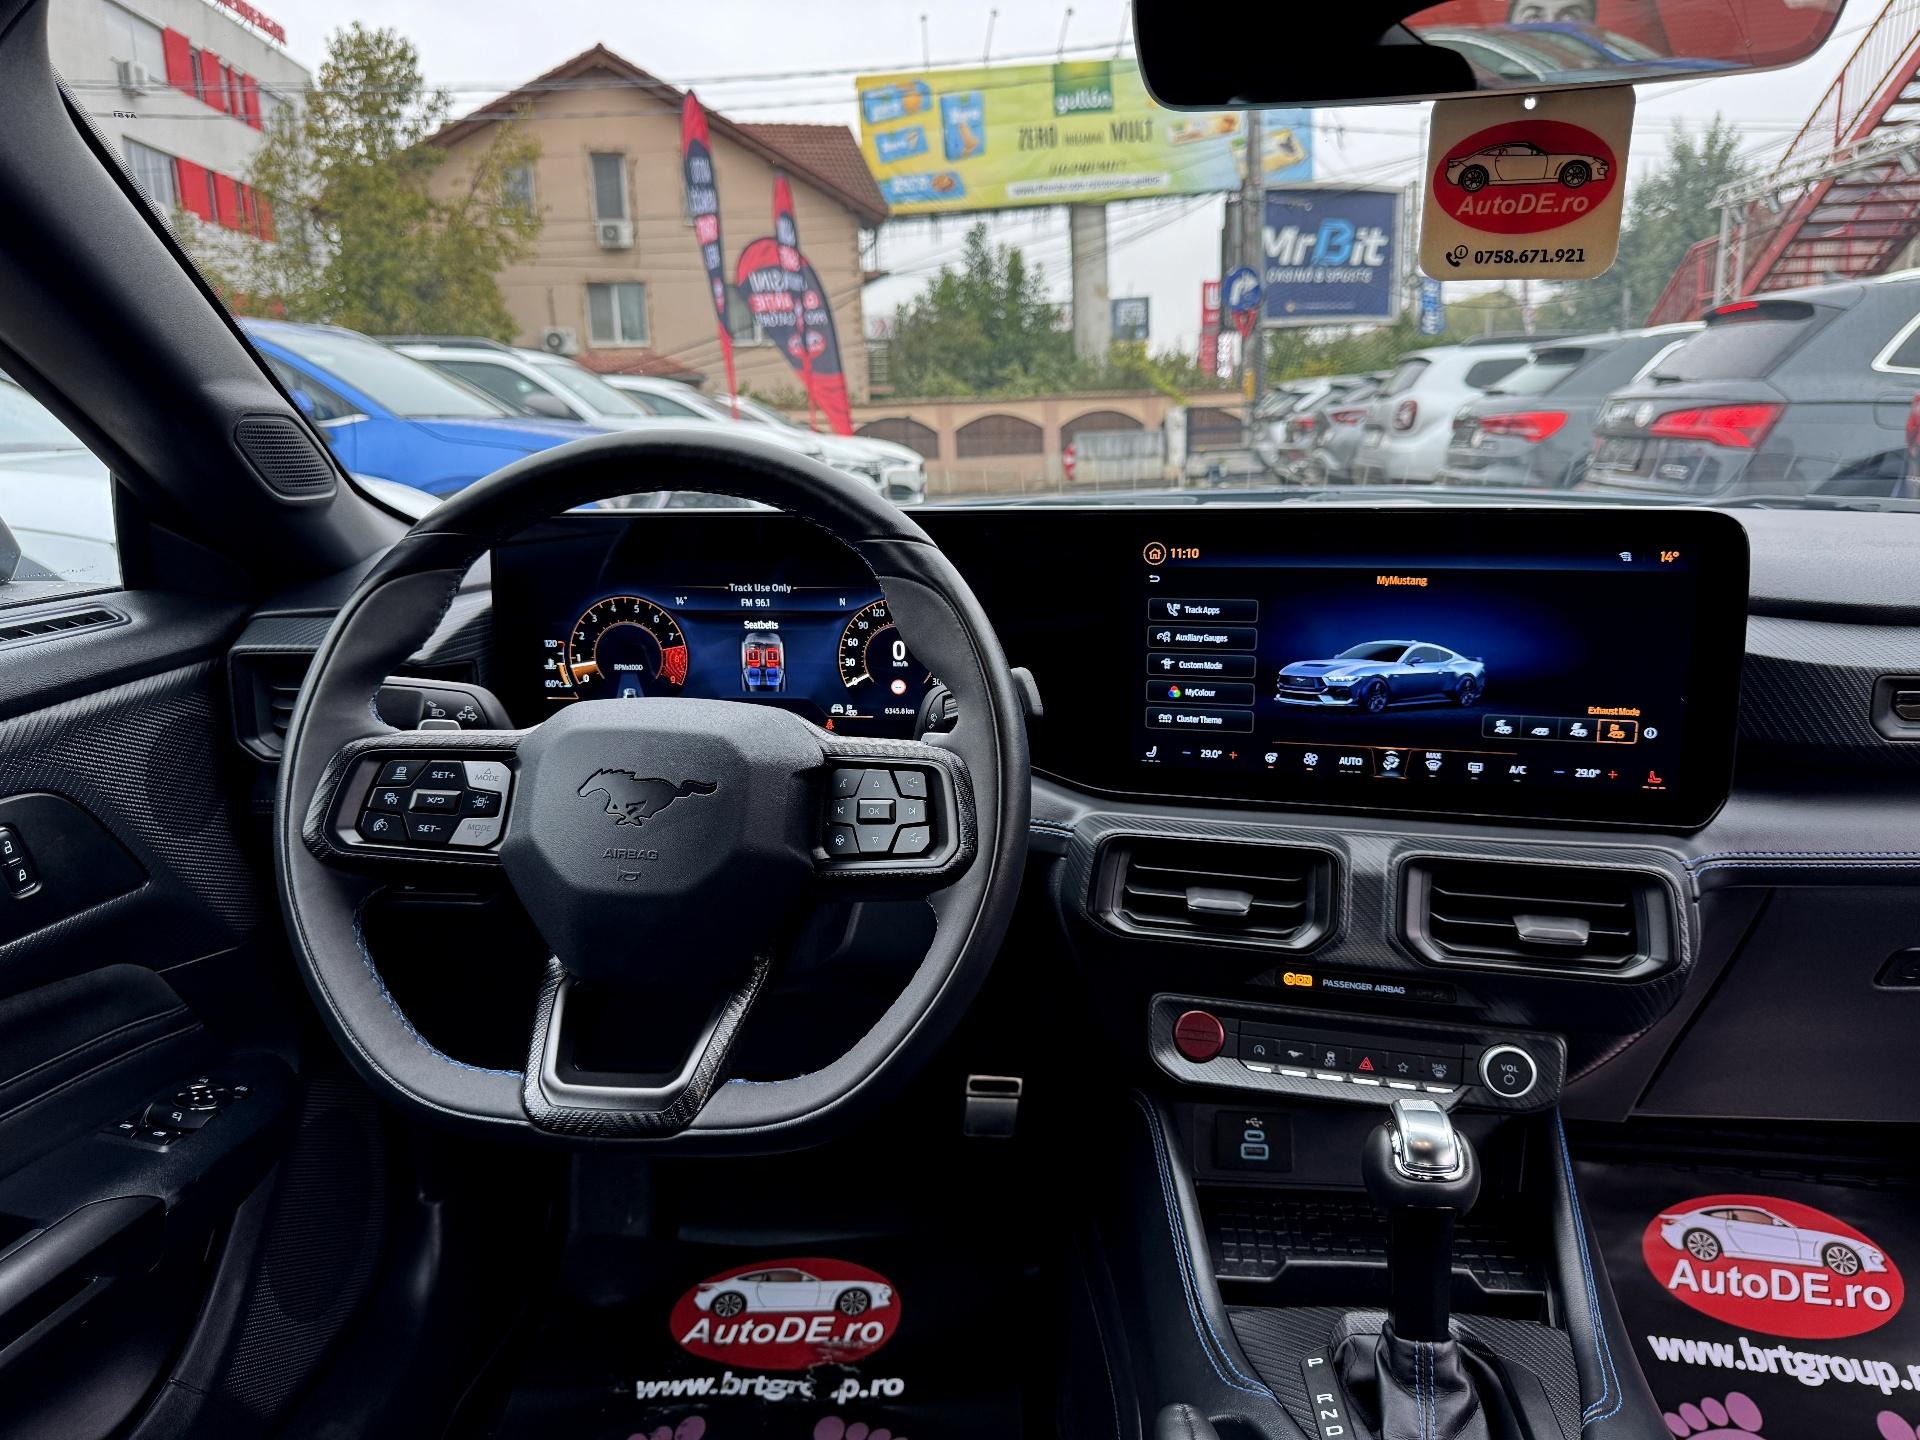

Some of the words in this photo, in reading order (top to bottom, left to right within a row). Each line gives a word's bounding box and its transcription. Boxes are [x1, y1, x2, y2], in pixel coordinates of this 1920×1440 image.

[1456, 193, 1589, 216] AutoDE.ro
[1474, 248, 1586, 265] 0758.671.921
[1170, 548, 1200, 559] 11:10
[1376, 575, 1427, 587] MyMustang
[729, 583, 753, 592] Track
[754, 584, 771, 592] Use
[772, 584, 792, 593] Only
[741, 599, 753, 607] FM
[755, 599, 770, 607] 96.1
[839, 598, 846, 606] N
[633, 605, 640, 613] 5
[872, 609, 885, 617] 120
[1184, 606, 1202, 614] Track
[1203, 606, 1220, 615] Apps
[653, 615, 660, 623] 6
[744, 620, 779, 630] Seatbelts
[858, 622, 869, 630] 90
[668, 633, 675, 641] 7
[1175, 634, 1203, 643] Auxiliary
[1203, 634, 1228, 643] Gauges
[544, 640, 558, 648] 120
[847, 638, 858, 647] 60
[892, 640, 906, 660] 0
[674, 655, 680, 663] 8
[845, 658, 855, 667] 30
[1179, 661, 1203, 669] Custom
[1204, 662, 1223, 670] Mode
[583, 675, 589, 683] 0
[1185, 688, 1216, 697] MyColour
[1587, 706, 1618, 716] Exhaust
[1618, 707, 1641, 716] Mode
[1176, 715, 1199, 723] Cluster
[1200, 716, 1222, 724] Theme
[1338, 756, 1363, 766] AUTO
[1509, 765, 1527, 774] A/C
[431, 771, 456, 779] SET+
[868, 807, 880, 815] OK
[467, 823, 492, 832] MODE
[602, 848, 659, 860] AIRBAG
[1322, 979, 1372, 991] PASSENGER
[1374, 984, 1405, 994] AIRBAG
[1501, 1063, 1519, 1073] VOL
[1668, 1258, 1892, 1312] AutoDE.ro
[680, 1316, 885, 1345] AutoDE.ro
[1308, 1358, 1323, 1367] P
[636, 1371, 905, 1405] www.brtgrop.ro
[1316, 1393, 1334, 1404] R
[1320, 1408, 1338, 1420] N
[1325, 1425, 1343, 1437] D
